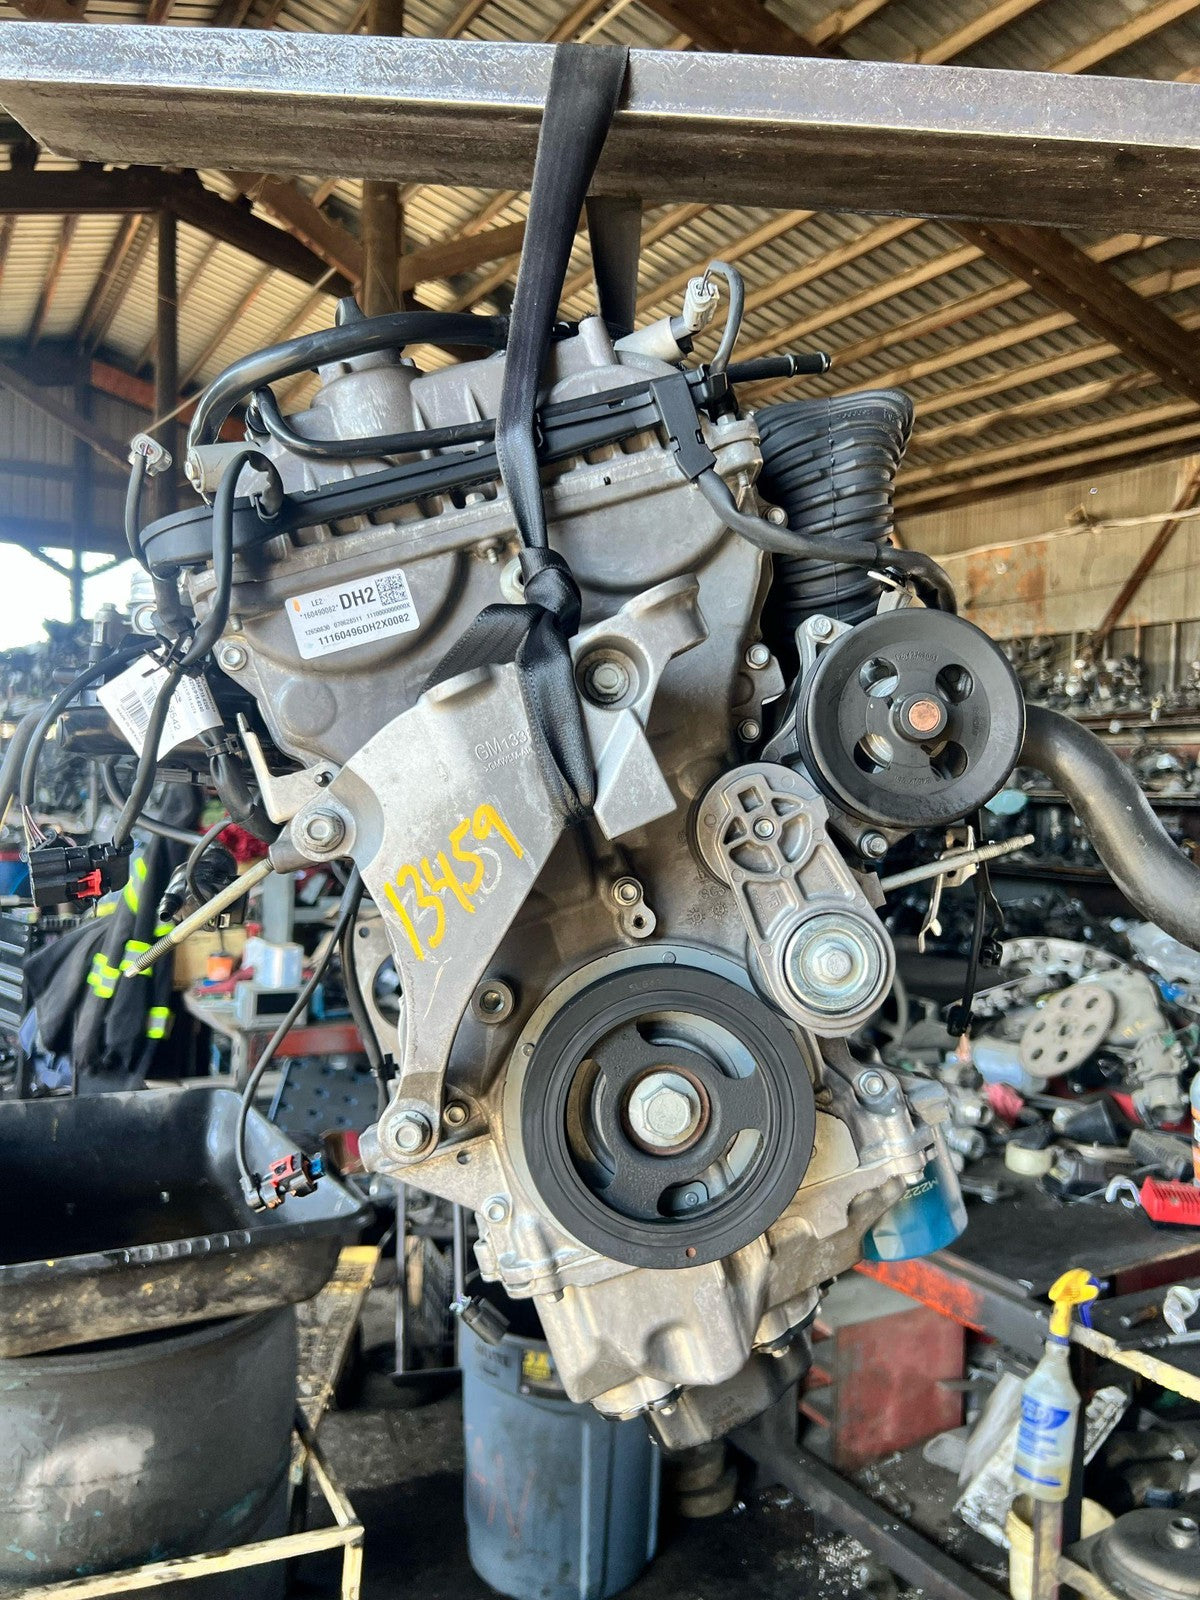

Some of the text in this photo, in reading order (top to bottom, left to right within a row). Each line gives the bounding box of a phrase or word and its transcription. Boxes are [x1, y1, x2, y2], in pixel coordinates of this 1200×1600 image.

[310, 598, 323, 607] LE2
[339, 586, 376, 610] DH2
[318, 613, 410, 645] 11160496DH2X0082
[384, 803, 525, 962] 13459
[900, 1176, 939, 1200] M222
